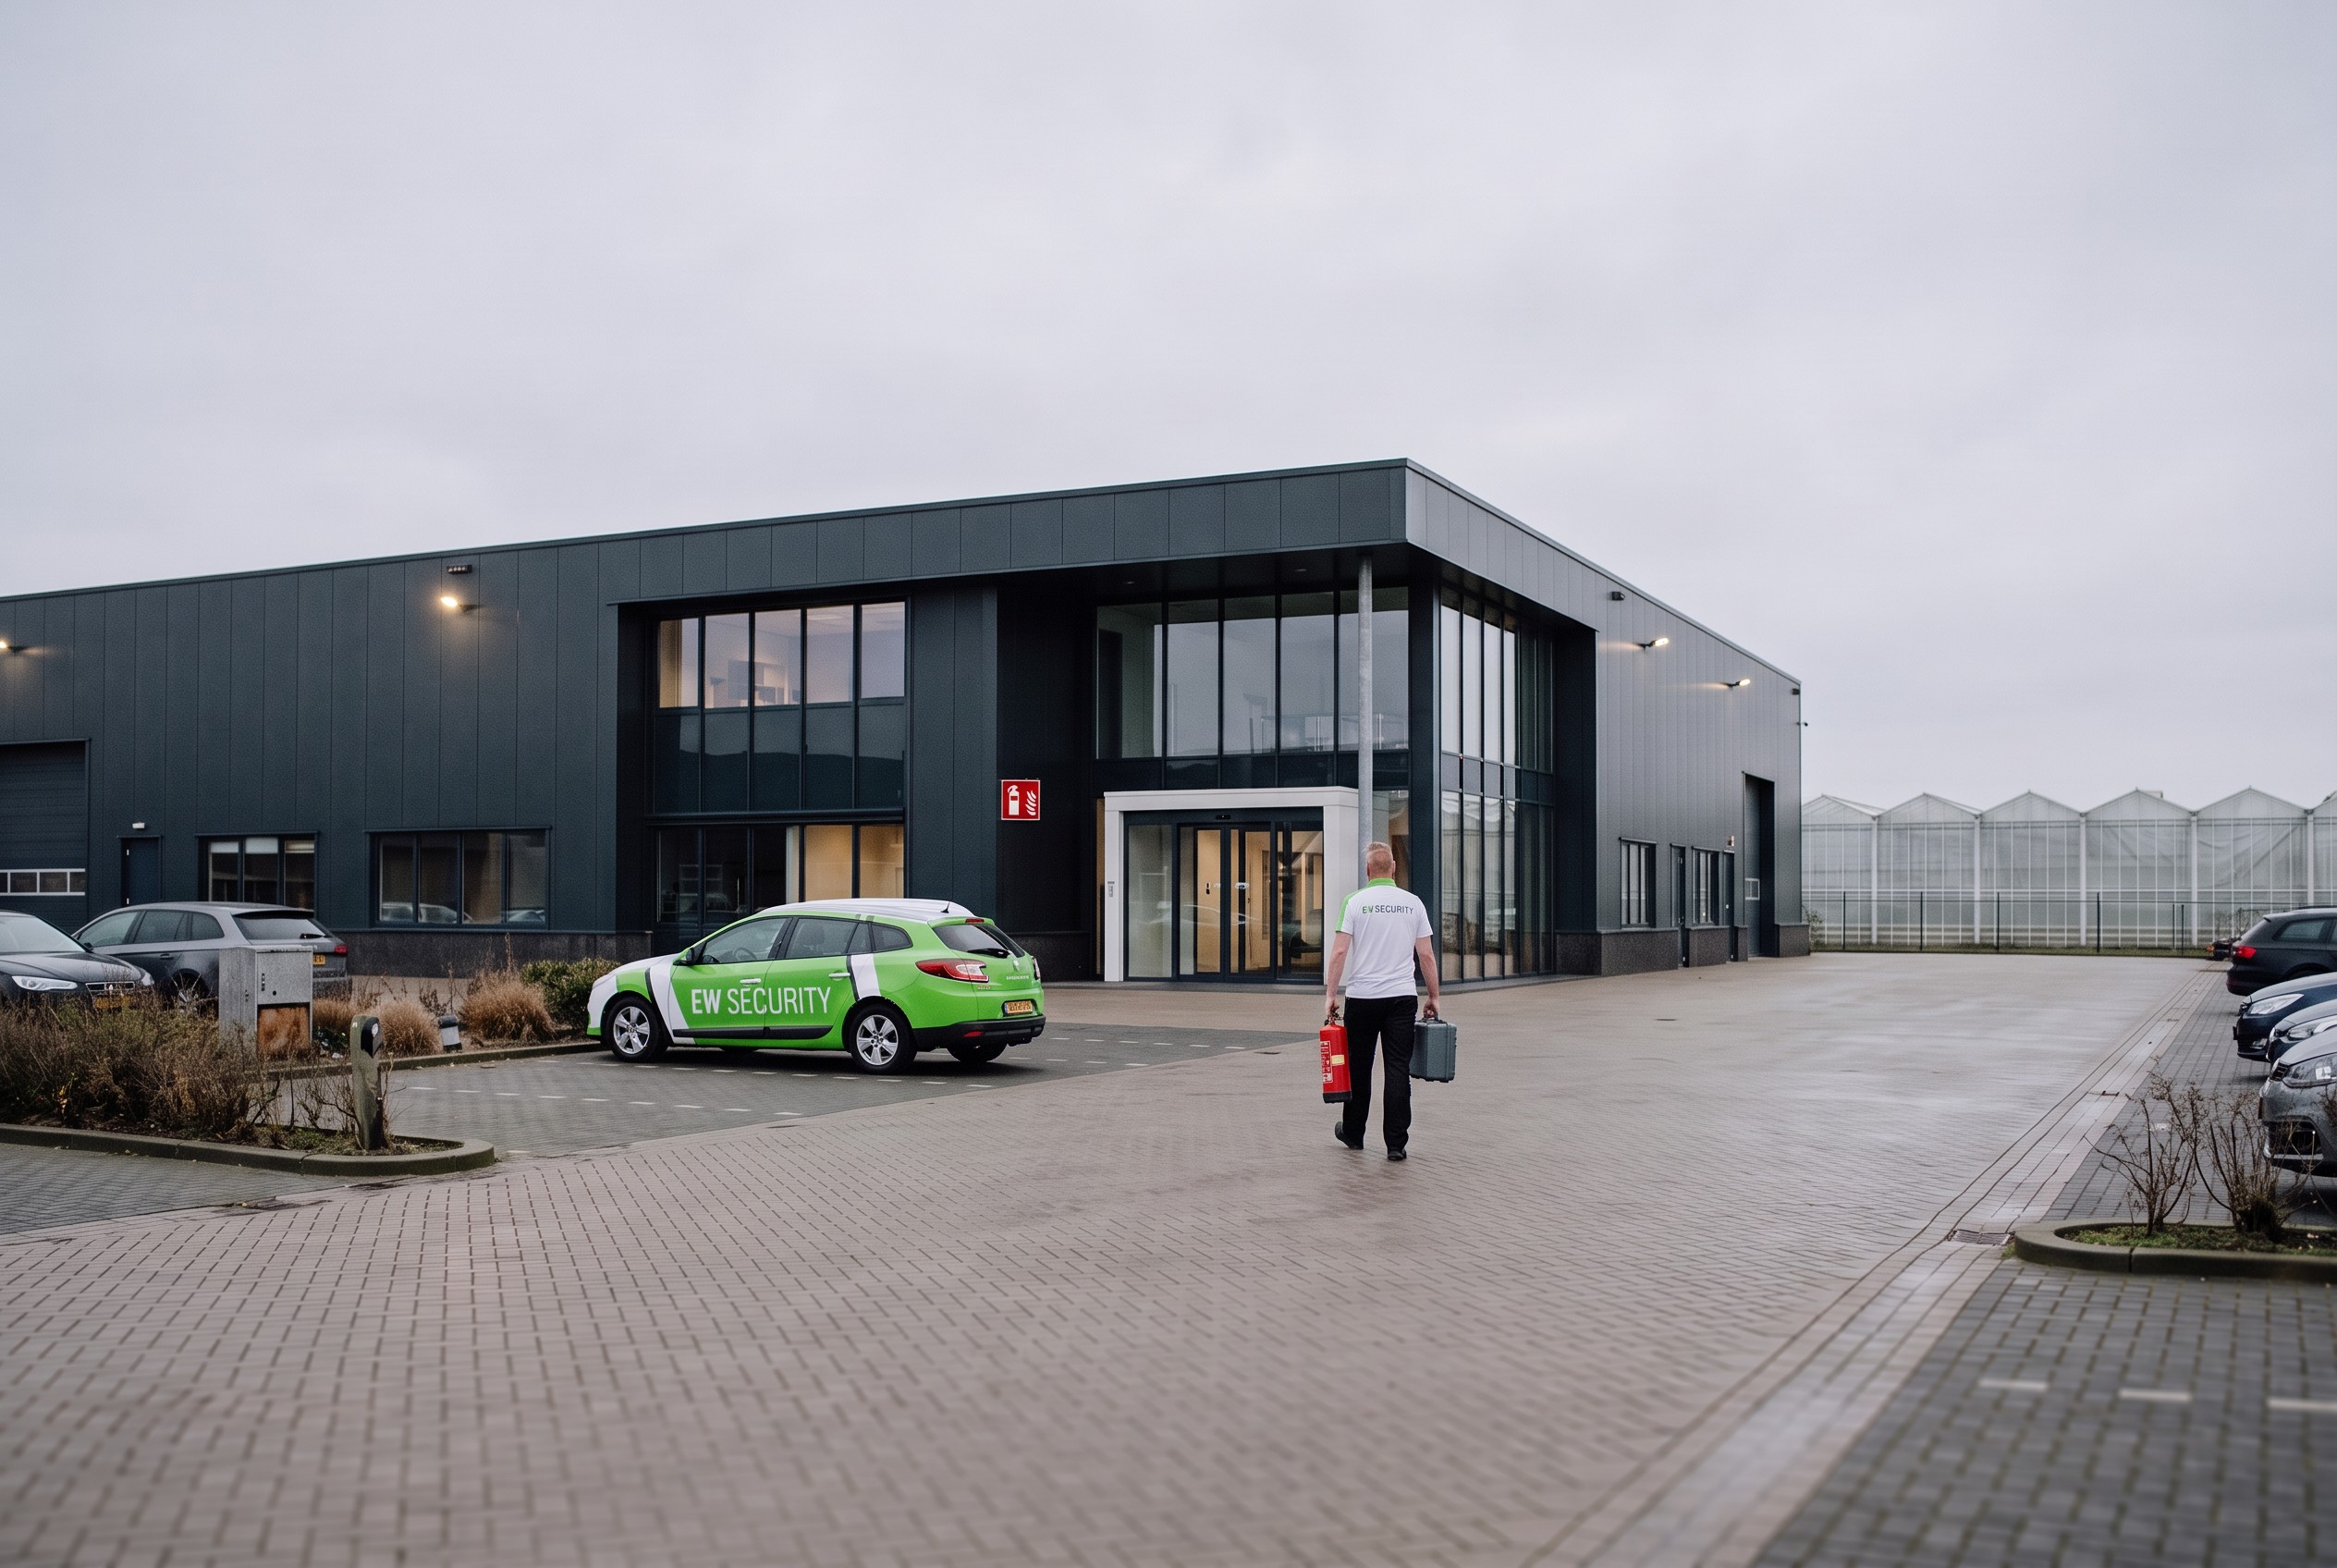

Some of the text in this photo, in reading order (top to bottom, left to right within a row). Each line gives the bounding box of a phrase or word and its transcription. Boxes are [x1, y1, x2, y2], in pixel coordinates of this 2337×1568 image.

[1375, 905, 1413, 914] SECURITY
[691, 986, 831, 1014] EW SECURITY
